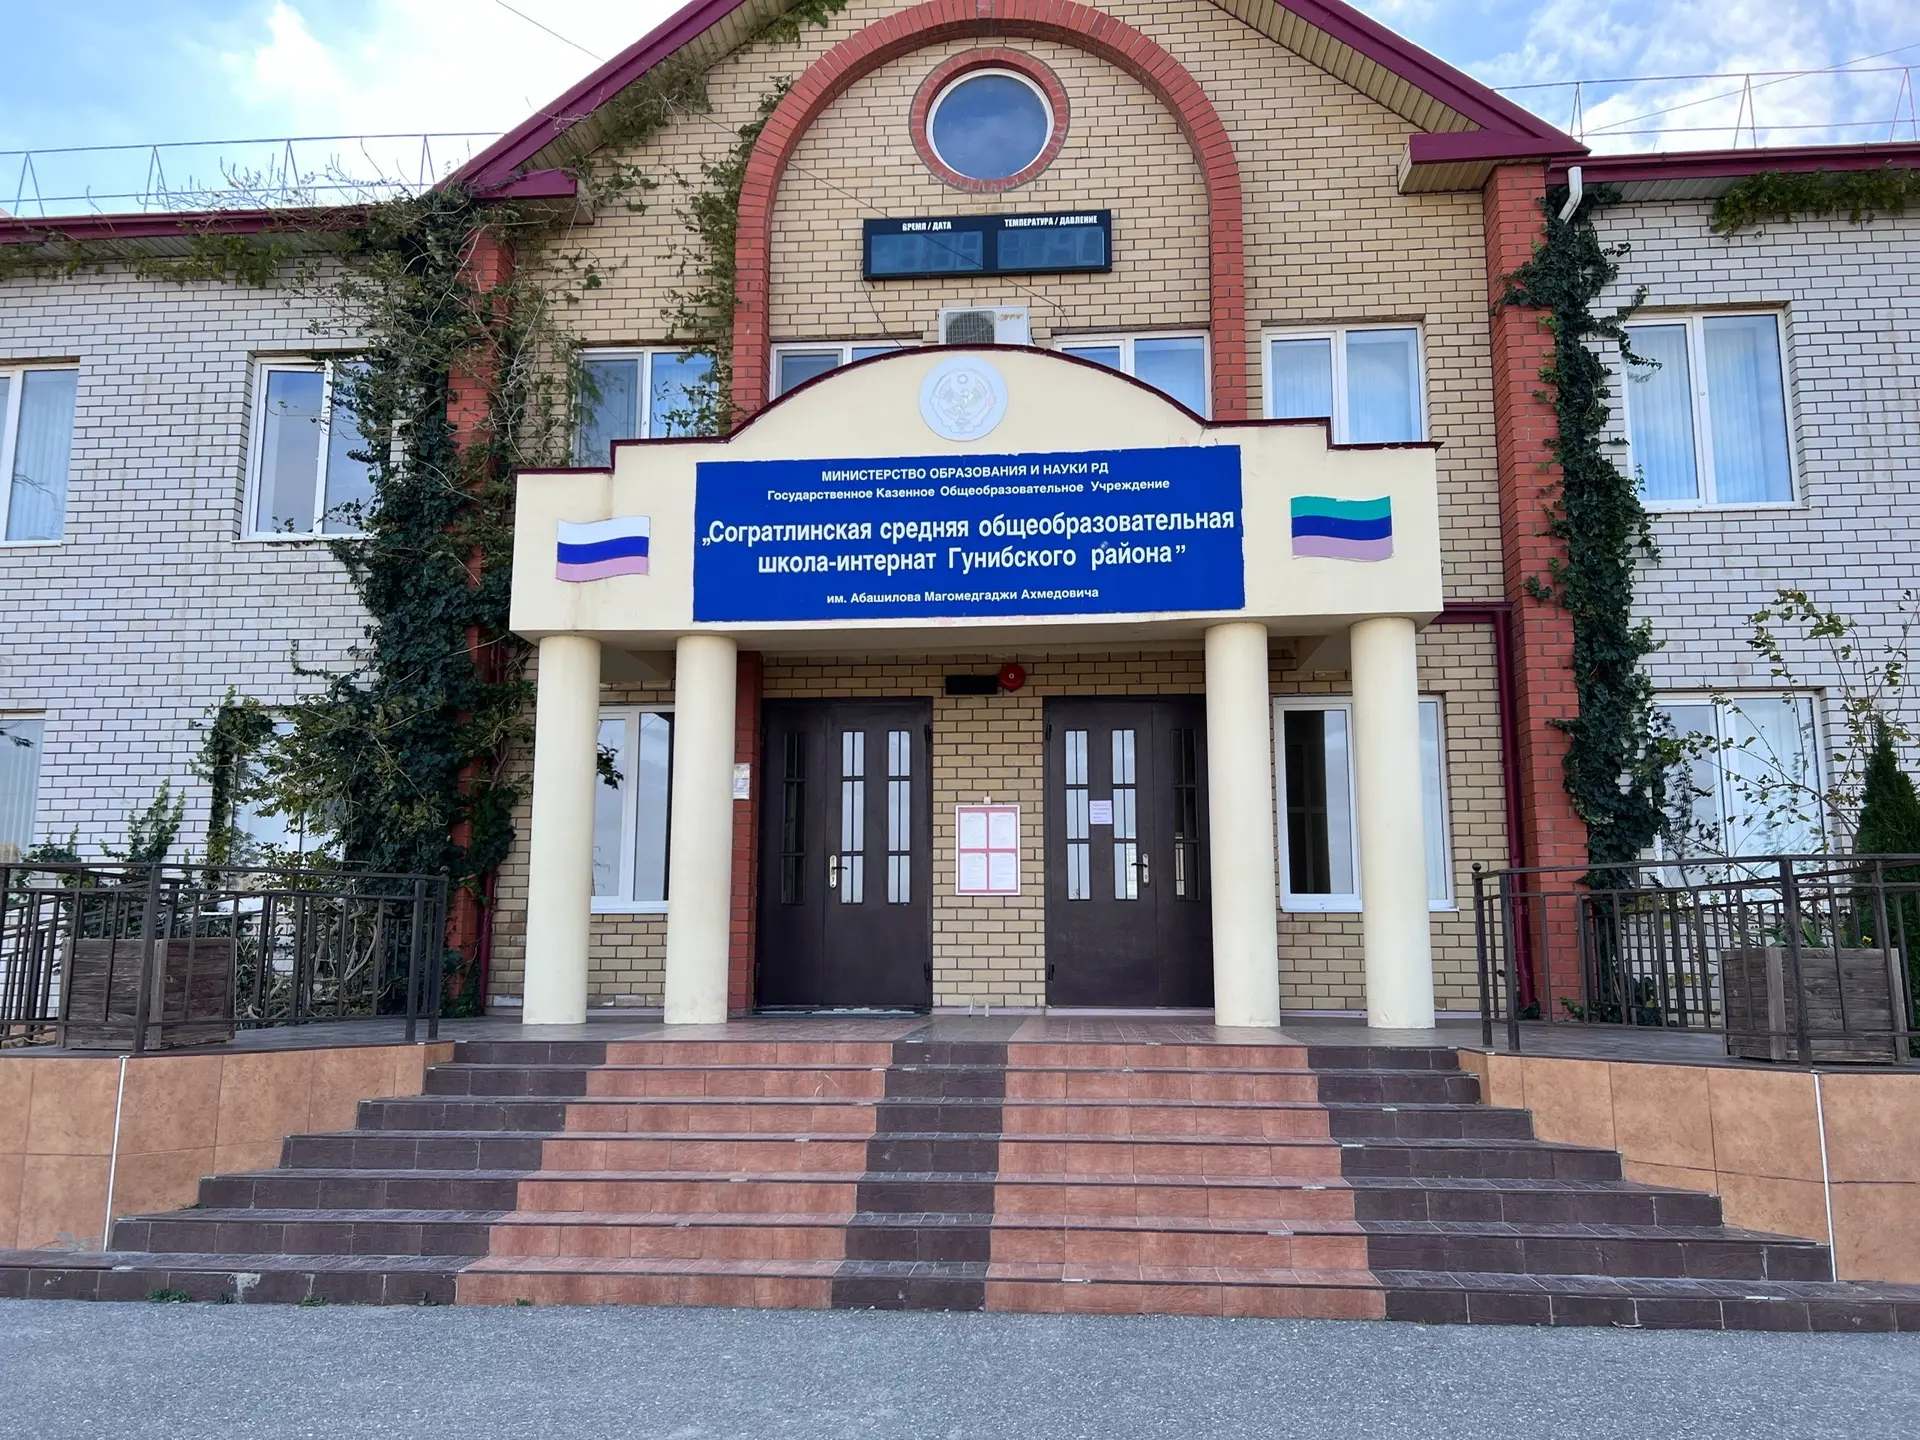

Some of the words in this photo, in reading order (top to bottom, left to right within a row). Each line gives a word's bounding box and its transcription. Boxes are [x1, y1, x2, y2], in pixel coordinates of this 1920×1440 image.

[932, 221, 952, 231] ДАТА
[1004, 217, 1054, 228] ТЕМПЕРАТУРА
[1059, 215, 1098, 226] ДАВЛЕНИЕ
[821, 468, 926, 482] МИНИСТЕРСТВО
[929, 465, 1026, 479] ОБРАЗОВАНИЯ
[1031, 464, 1040, 475] И
[1043, 463, 1088, 475] НАУКИ
[1091, 462, 1109, 475] РД
[767, 489, 873, 502] Государственное
[876, 487, 935, 498] Казенное
[940, 483, 1084, 498] Общеобразовательное
[1090, 480, 1170, 493] Учреждение
[702, 519, 872, 547] „Согратлинская
[879, 520, 969, 544] средняя
[978, 511, 1235, 539] общеобразовательная
[758, 552, 937, 576] школа-интернат
[948, 546, 1077, 574] Гунибского
[826, 595, 847, 604] им.
[850, 592, 921, 603] Абашилова
[924, 591, 1018, 603] Магомедгаджи
[1020, 588, 1099, 600] Ахмедовича
